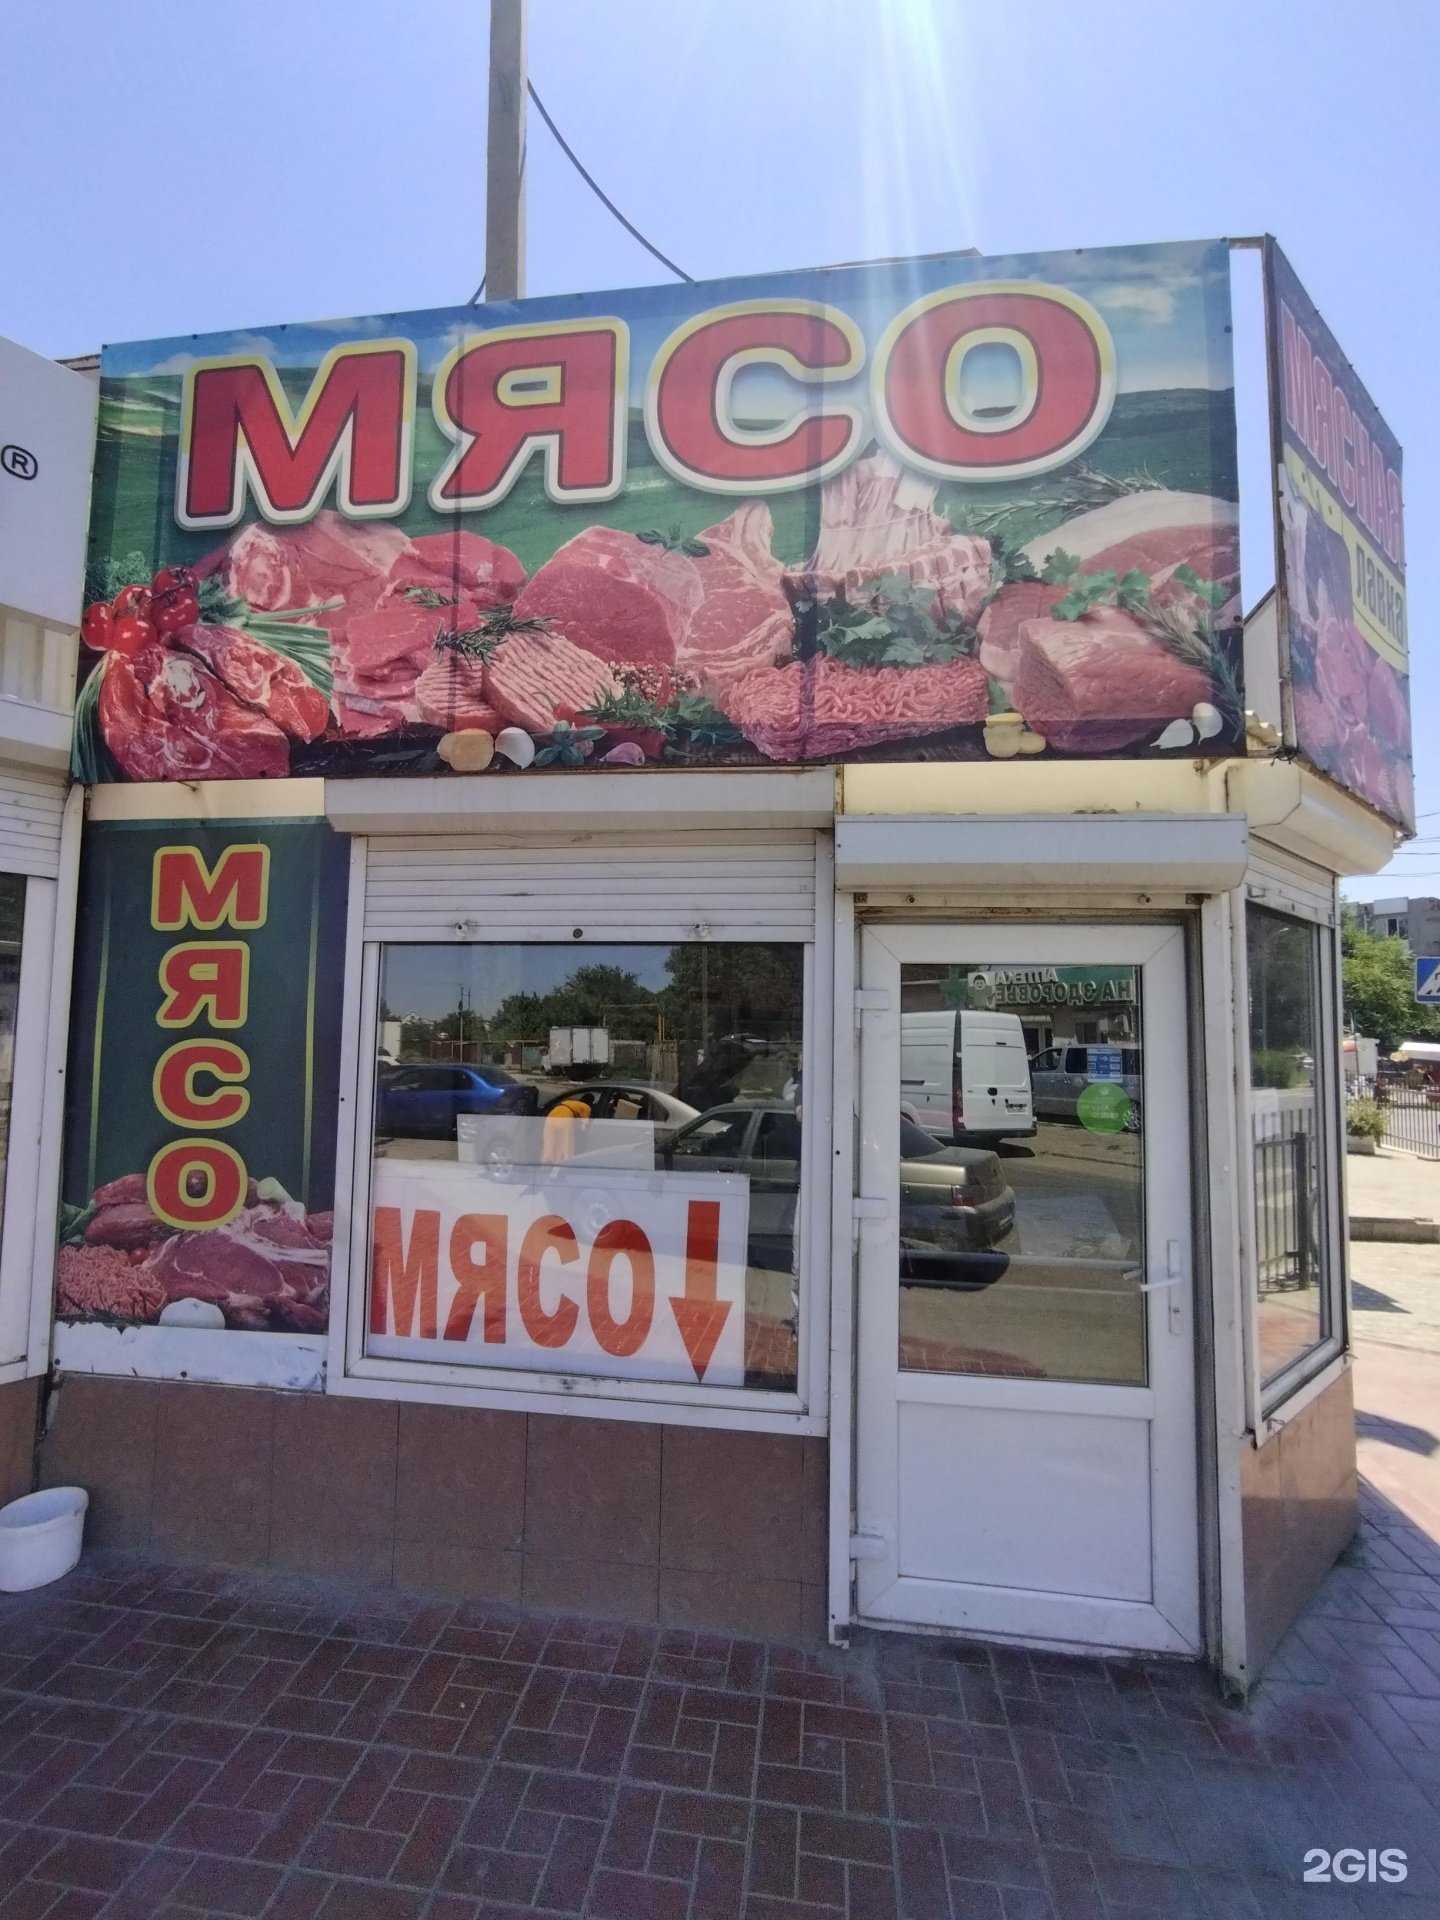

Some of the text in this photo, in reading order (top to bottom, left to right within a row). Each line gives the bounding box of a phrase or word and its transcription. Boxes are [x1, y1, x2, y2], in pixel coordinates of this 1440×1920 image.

[176, 281, 1116, 530] МЯСО
[147, 842, 271, 1231] МЯСО
[370, 1206, 655, 1357] МЯСО
